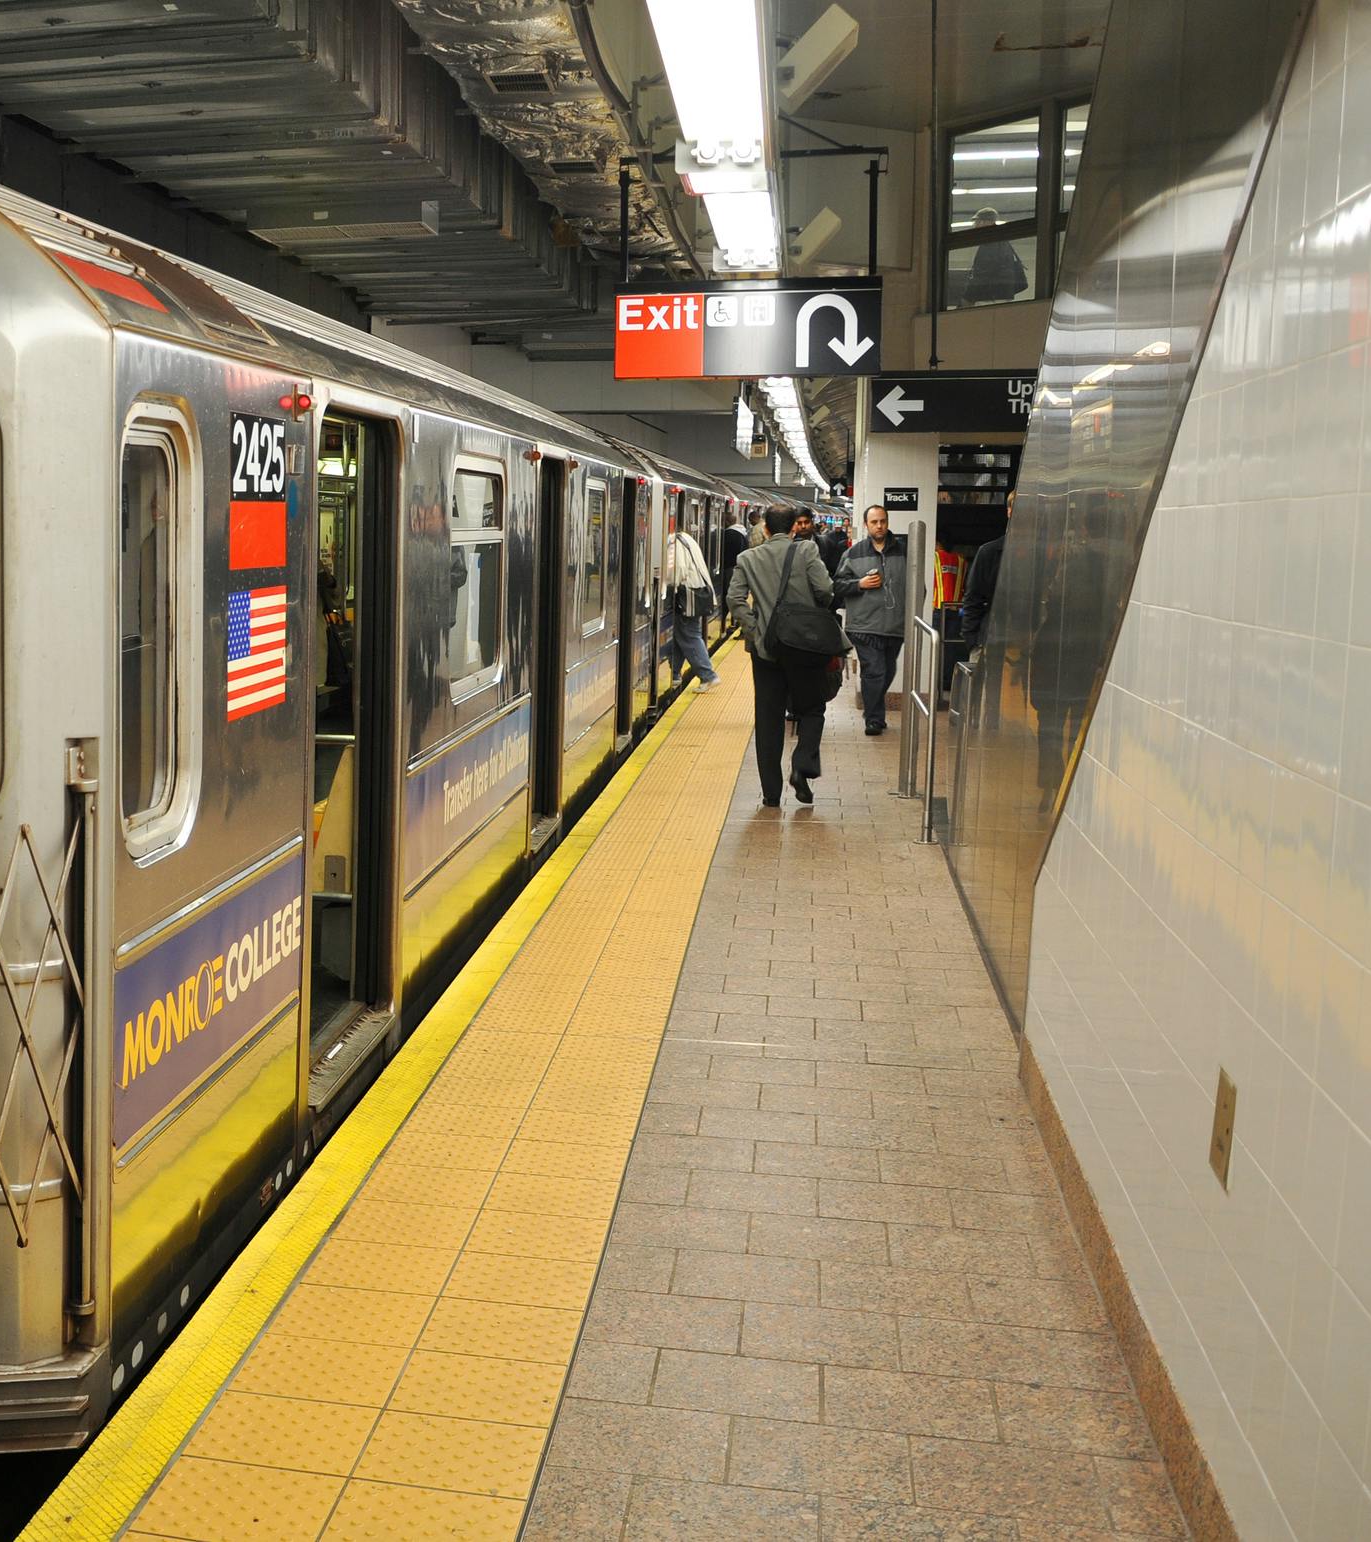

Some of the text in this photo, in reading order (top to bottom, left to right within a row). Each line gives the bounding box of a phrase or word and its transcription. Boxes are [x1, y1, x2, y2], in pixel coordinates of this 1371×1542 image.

[619, 297, 699, 331] Exit
[232, 419, 285, 493] 2425
[885, 493, 916, 502] Track 1
[443, 766, 473, 825] Transfer
[474, 760, 488, 801] here
[489, 748, 499, 789] for
[123, 896, 301, 1088] MONROE COLLEGE
